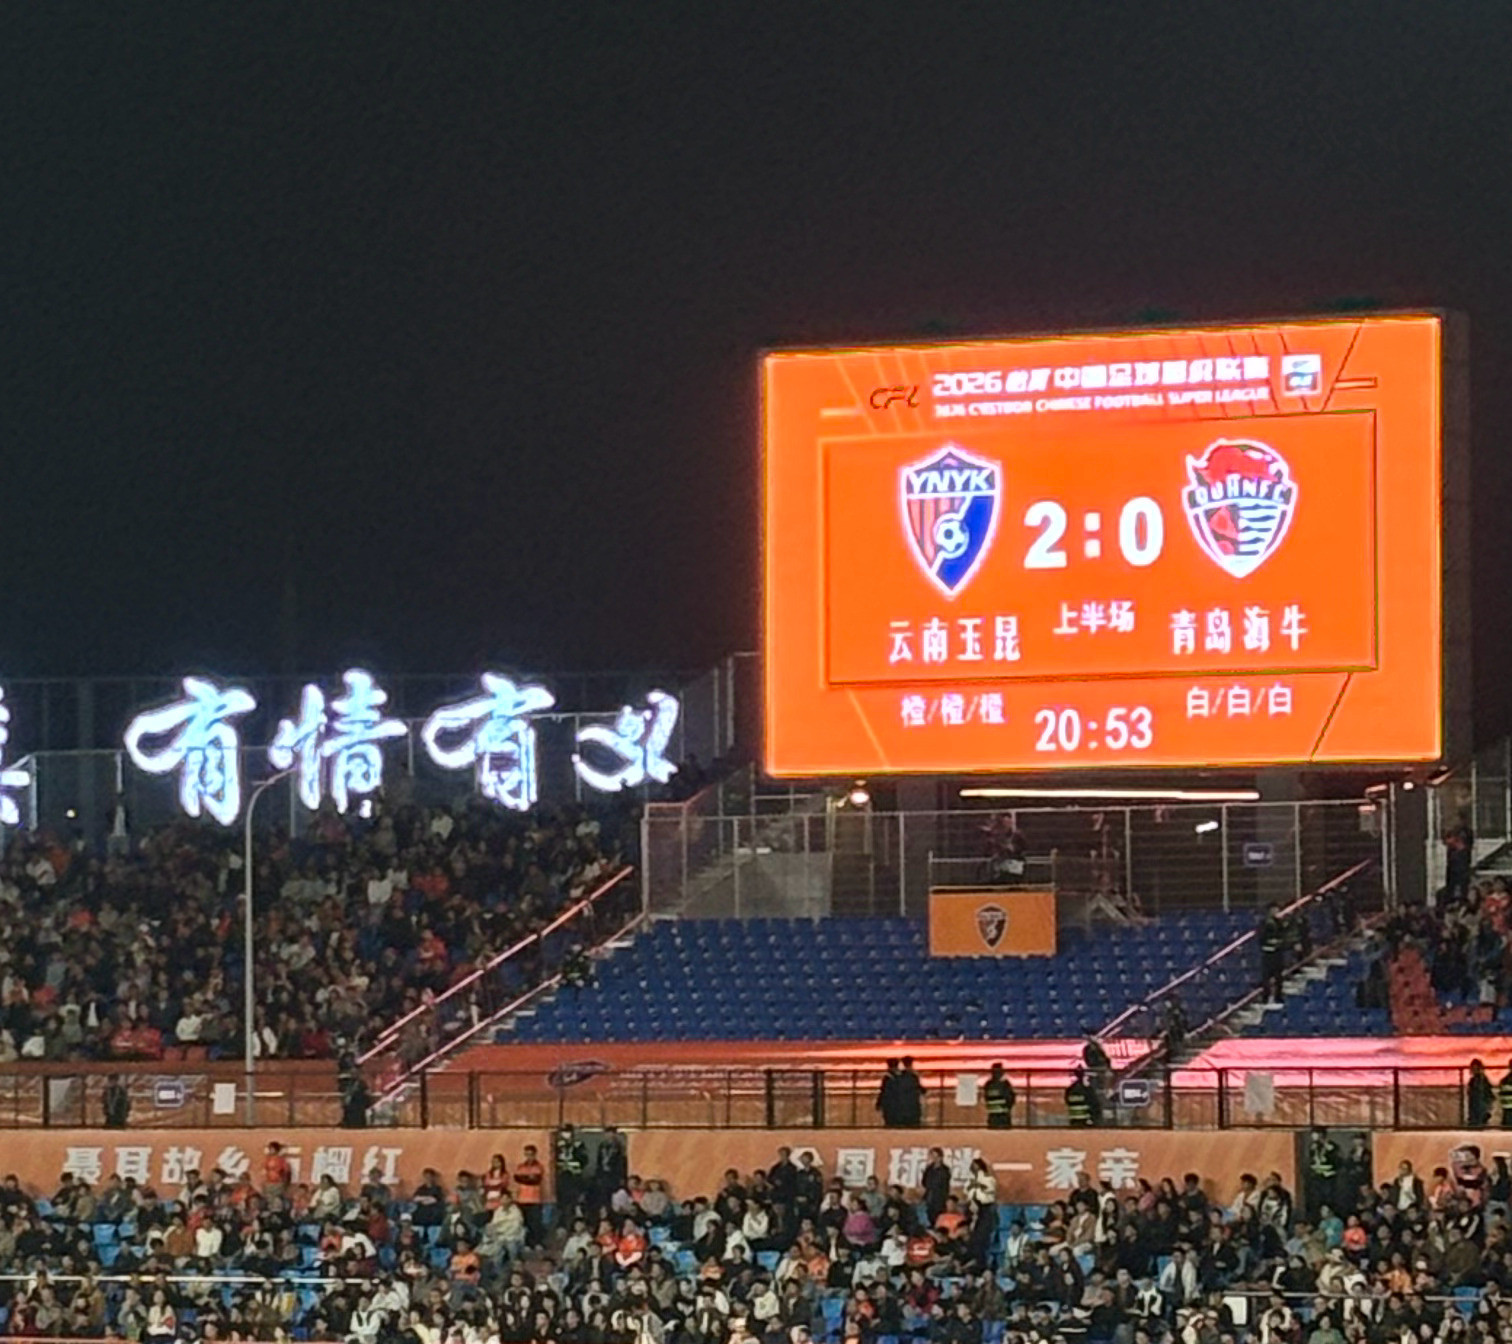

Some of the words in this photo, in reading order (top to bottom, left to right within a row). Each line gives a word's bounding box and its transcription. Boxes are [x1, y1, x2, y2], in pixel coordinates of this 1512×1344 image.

[908, 470, 991, 494] YNYK
[1022, 497, 1164, 569] 2:0
[889, 616, 1022, 664] 云南玉昆
[1053, 601, 1136, 634] 上半场
[1170, 605, 1309, 656] 青岛海牛
[1186, 684, 1294, 718] 白/白/白
[1035, 707, 1154, 752] 20:53
